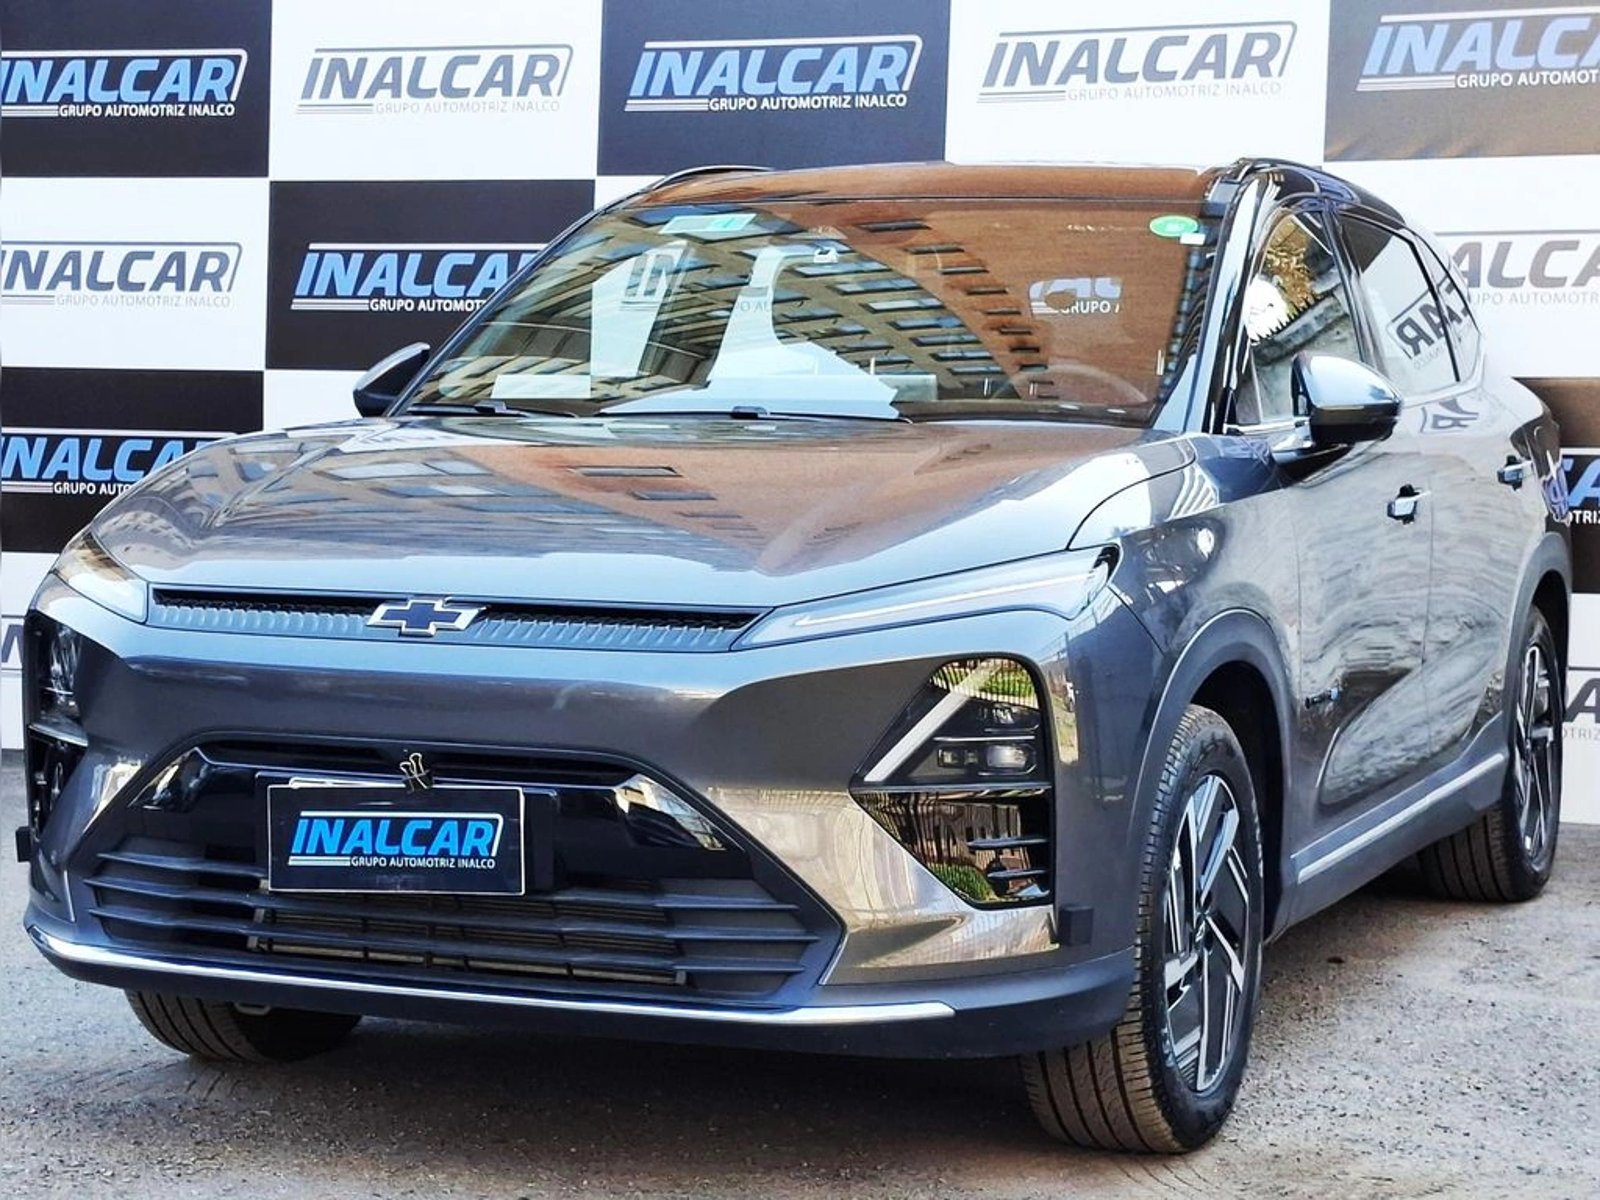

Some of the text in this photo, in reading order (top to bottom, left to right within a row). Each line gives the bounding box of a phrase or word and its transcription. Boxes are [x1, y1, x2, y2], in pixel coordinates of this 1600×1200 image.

[1362, 16, 1600, 76] INALC
[982, 32, 1282, 88] INALCAR
[301, 54, 560, 99] INALCAR
[630, 46, 910, 97] INALCAR
[1457, 73, 1513, 89] GRUPO
[1067, 81, 1281, 101] GRUPO AUTOMOTRIZ INALCO
[59, 103, 236, 118] GRUPO AUTOMOTRIZ INALCO
[375, 100, 561, 115] GRUPO AUTOMOTRIZ INALCO
[708, 94, 907, 111] GRUPO AUTOMOTRIZ INALCO
[1, 249, 231, 293] NALCAR
[294, 251, 537, 298] INALCA
[57, 295, 232, 308] GRUPO AUTOMOTRIZ INALCO
[369, 299, 415, 312] GRUPO
[1, 436, 213, 483] NALCA
[53, 481, 97, 494] GRUPO
[291, 818, 495, 856] INALCAR
[351, 856, 496, 869] GRUPO AUTOMOTRIZ INALCO
